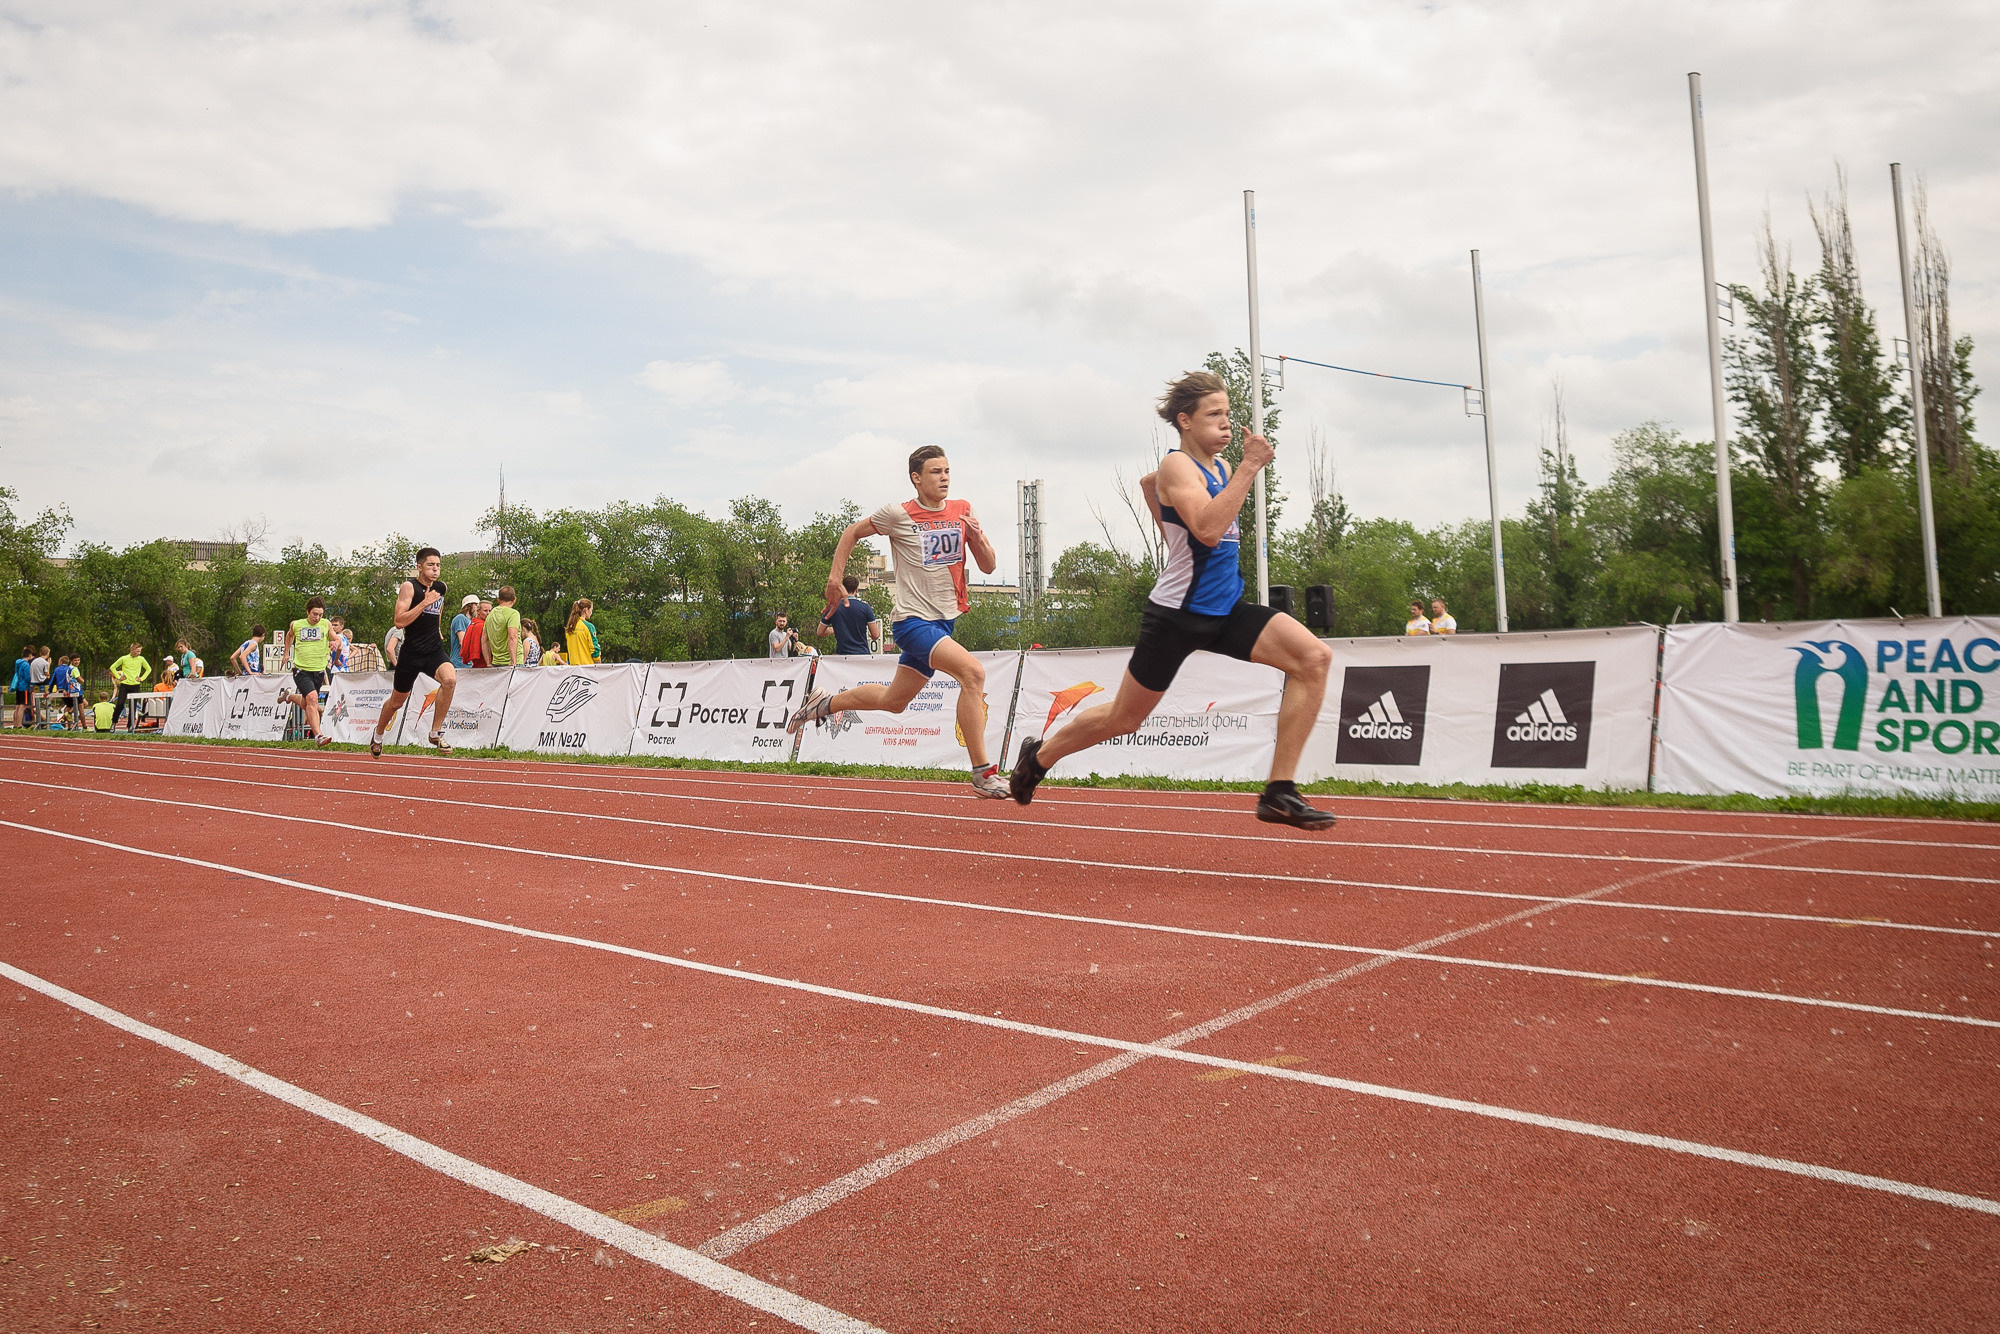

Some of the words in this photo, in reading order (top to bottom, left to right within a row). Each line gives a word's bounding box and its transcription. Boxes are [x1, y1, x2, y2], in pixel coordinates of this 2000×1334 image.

[911, 522, 930, 533] PRO
[934, 521, 961, 529] TEAM
[930, 533, 959, 555] 207
[276, 632, 282, 642] 5
[307, 629, 317, 637] 69
[1876, 637, 2000, 673] PEAC
[930, 680, 962, 690] УЧРЕЖДЕН
[1876, 679, 1984, 714] AND
[247, 703, 273, 717] Ростех
[689, 703, 748, 724] Ростех
[1212, 712, 1248, 731] фонд
[1127, 731, 1209, 747] Исинбаевой
[1348, 722, 1413, 740] adidas
[1506, 723, 1578, 742] adidas
[1874, 718, 2000, 755] SPOR
[538, 732, 557, 747] МК
[558, 732, 586, 748] №20
[648, 734, 676, 745] Ростех
[752, 736, 783, 748] Ростех
[898, 738, 918, 747] АРМИИ
[1787, 761, 1807, 777] BE
[1812, 762, 1854, 779] PART
[1858, 764, 1885, 780] OF
[1889, 765, 1942, 782] WHAT
